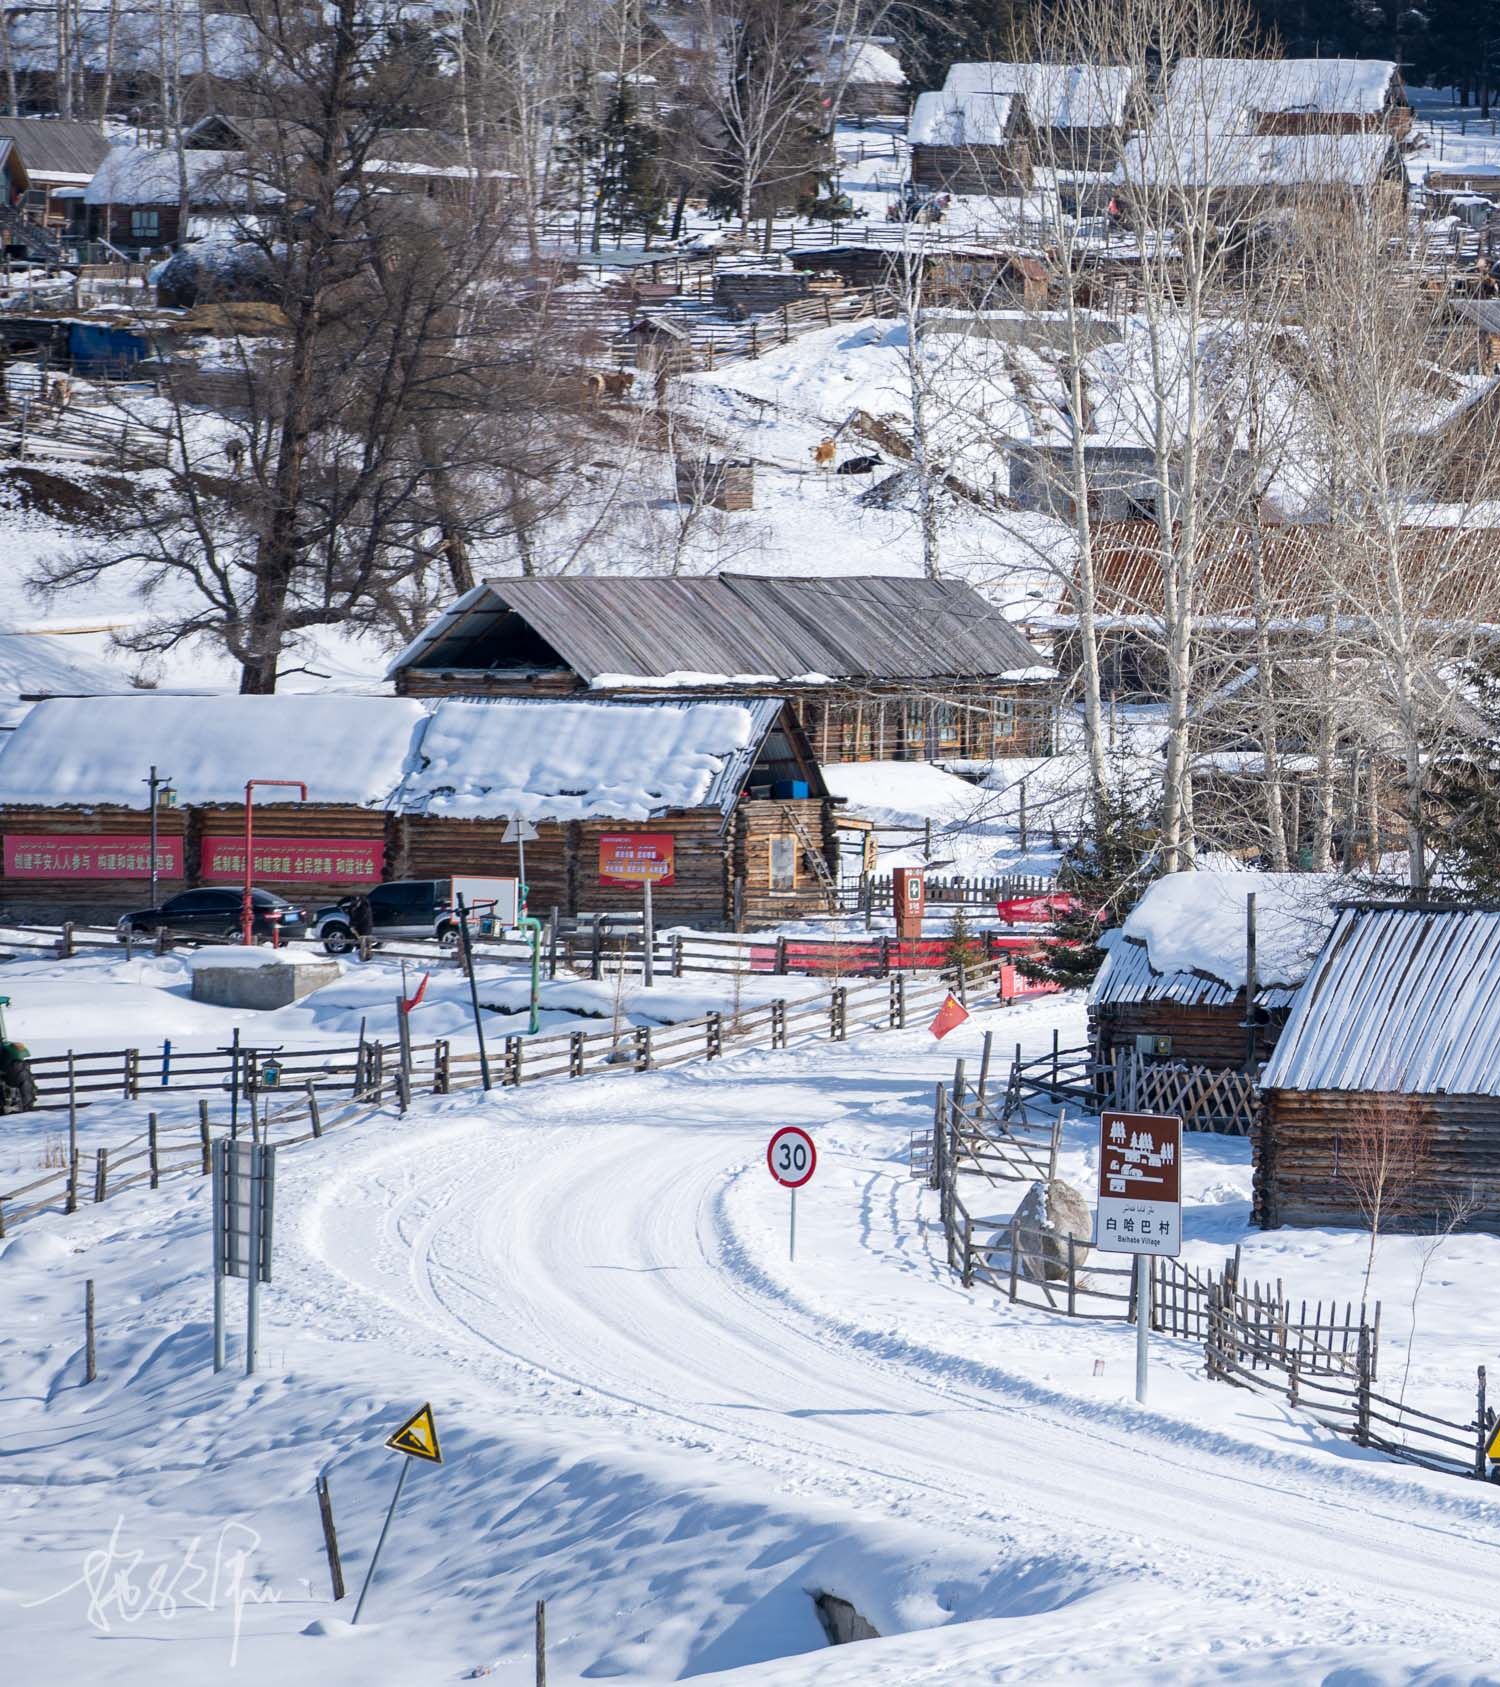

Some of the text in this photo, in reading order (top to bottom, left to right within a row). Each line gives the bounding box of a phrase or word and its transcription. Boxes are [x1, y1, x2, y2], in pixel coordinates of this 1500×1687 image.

[336, 858, 375, 875] 和谐社会
[779, 1143, 807, 1171] 30
[1106, 1217, 1170, 1236] 白哈巴村
[1141, 1237, 1161, 1247] Village
